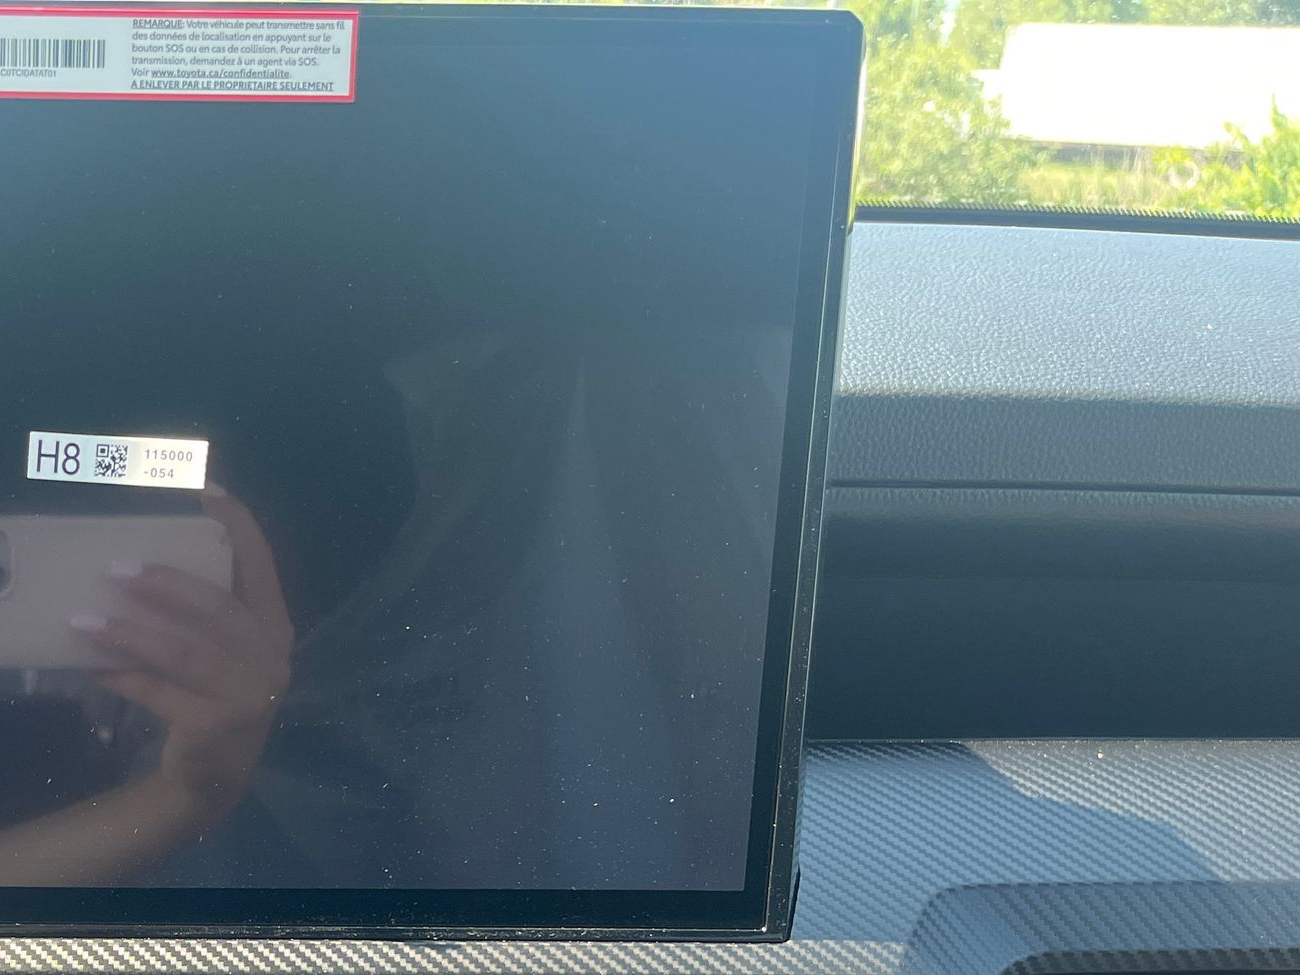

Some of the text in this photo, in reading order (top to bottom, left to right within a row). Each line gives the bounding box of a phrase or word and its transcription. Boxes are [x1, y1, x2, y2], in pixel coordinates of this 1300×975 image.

[132, 20, 184, 28] REMARQUE:
[186, 20, 209, 28] Votre
[210, 20, 244, 29] véhicule
[246, 22, 264, 30] peut
[267, 22, 314, 30] transmettre
[336, 22, 345, 30] fil
[132, 32, 148, 40] des
[150, 32, 186, 40] données
[189, 32, 200, 40] de
[202, 32, 250, 41] localisation
[266, 34, 306, 44] appuyant
[324, 33, 331, 42] le
[132, 44, 164, 52] bouton
[166, 44, 184, 52] SOS
[228, 45, 239, 53] de
[240, 45, 278, 54] collision.
[280, 46, 300, 54] Pour
[302, 46, 330, 54] arrêter
[332, 46, 340, 54] la
[132, 56, 188, 66] transmission,
[190, 56, 234, 65] demandez
[237, 57, 242, 65] à
[258, 58, 282, 67] agent
[299, 58, 320, 66] SOS.
[131, 68, 292, 79] Voir www.toyota.ca/confidentialite.
[131, 80, 334, 91] A ENLEVER PAR LE PROPRIETAIRE SEULEMENT
[36, 440, 80, 475] H8
[146, 450, 192, 461] 115000
[144, 468, 174, 478] -054
